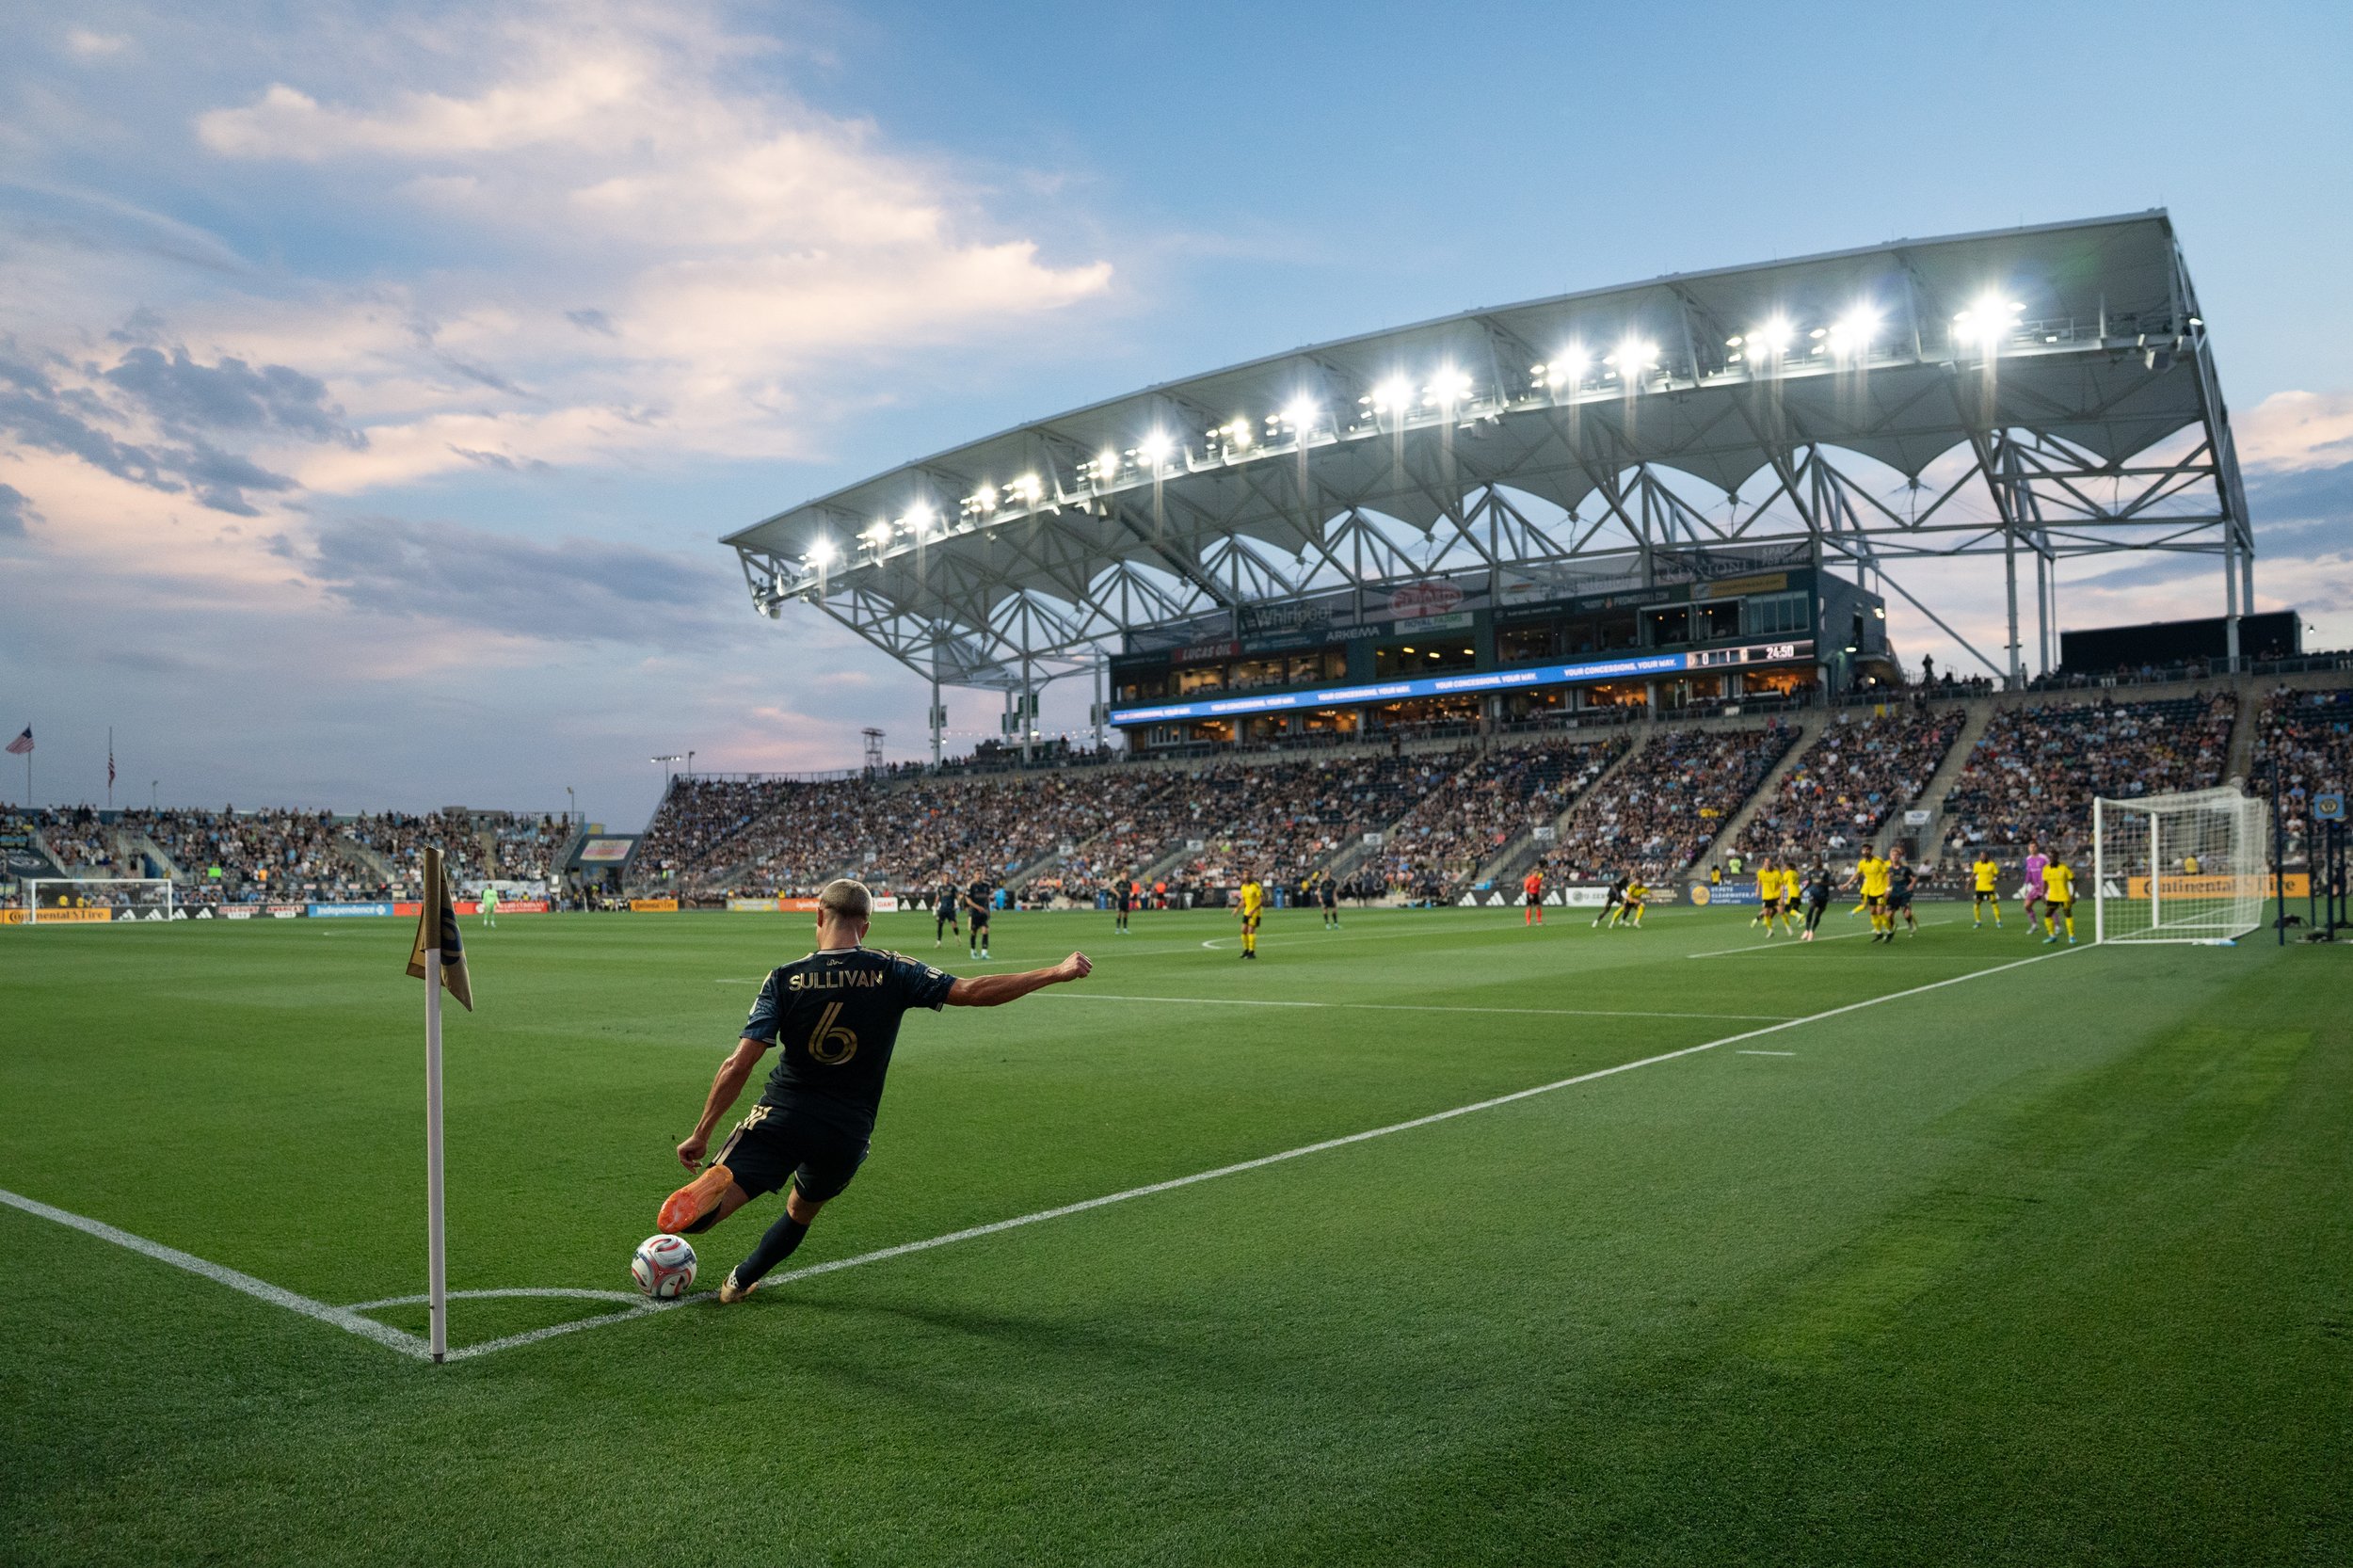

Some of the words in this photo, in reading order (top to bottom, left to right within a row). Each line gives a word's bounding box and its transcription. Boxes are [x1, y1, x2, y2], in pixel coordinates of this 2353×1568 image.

[1255, 600, 1333, 628] Whirlpool
[1325, 626, 1381, 642] ARKEMA
[1183, 646, 1215, 660] LUCAS
[1215, 644, 1231, 656] OIL
[1702, 652, 1709, 665] 0
[1726, 650, 1731, 663] 1
[1766, 645, 1795, 660] 24:50
[1564, 666, 1584, 677] YOUR
[1638, 661, 1657, 670] YOUR
[2143, 876, 2237, 895] Cntinental
[8, 910, 70, 922] Connental
[316, 904, 376, 916] Independence
[789, 969, 883, 992] SULLIVAN
[808, 1001, 858, 1065] 6
